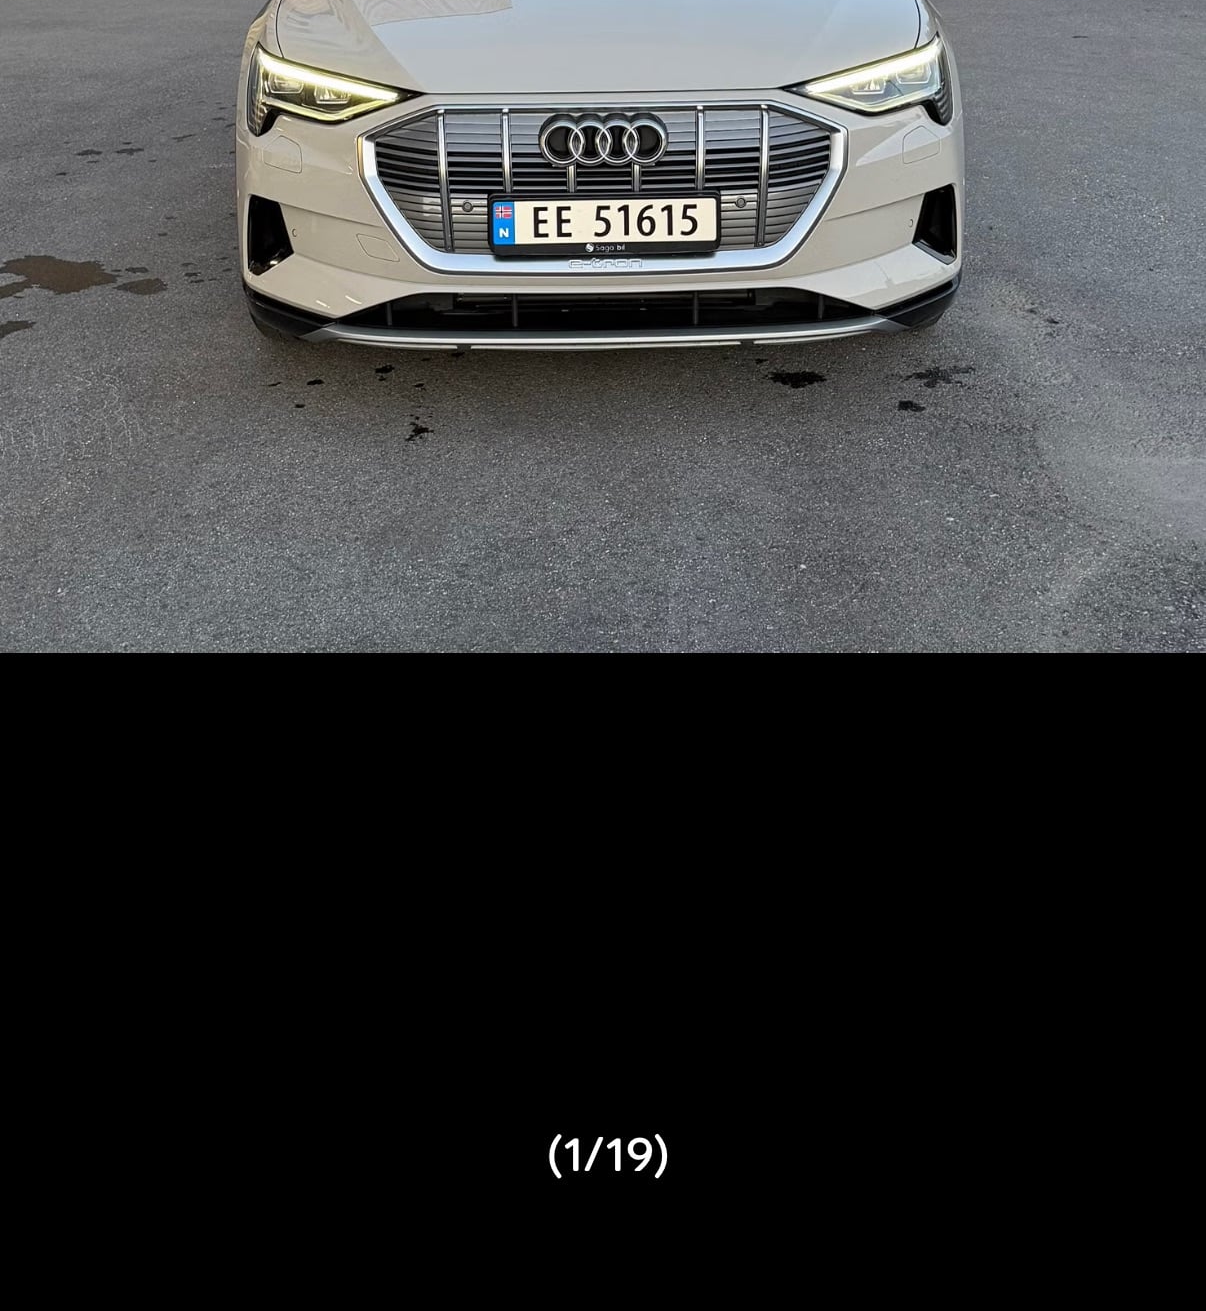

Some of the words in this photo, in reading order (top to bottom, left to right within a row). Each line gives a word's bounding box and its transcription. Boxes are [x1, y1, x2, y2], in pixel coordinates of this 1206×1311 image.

[533, 206, 573, 238] EE
[593, 204, 698, 237] 51615
[499, 227, 509, 238] N
[568, 258, 643, 269] e-tron
